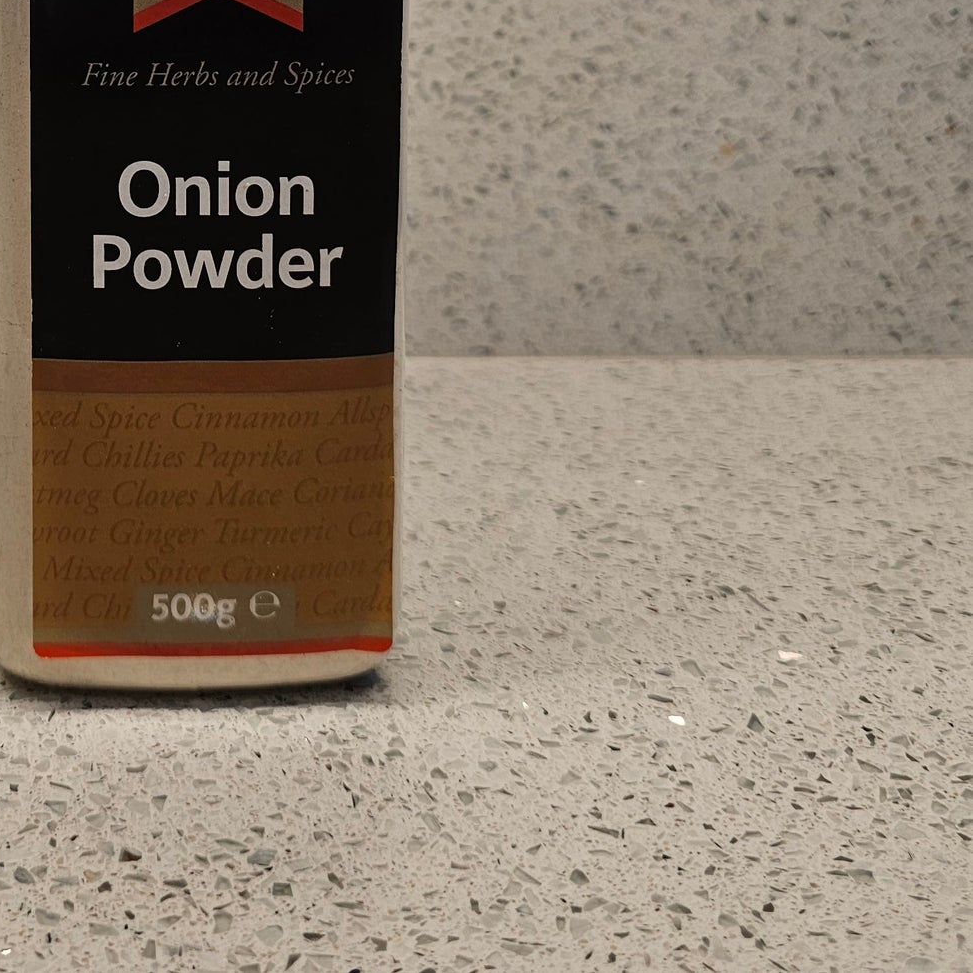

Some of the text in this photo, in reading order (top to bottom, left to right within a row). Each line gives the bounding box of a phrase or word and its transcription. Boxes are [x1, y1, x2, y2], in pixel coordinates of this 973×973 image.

[81, 61, 356, 94] Fine Herbs and Spices
[118, 160, 315, 218] Onion
[92, 233, 344, 290] Powder
[90, 401, 162, 438] Spice
[171, 401, 320, 429] Cinnamon
[82, 439, 185, 468] Chillies
[195, 439, 304, 477] Paprika
[112, 480, 198, 508] Cloves
[205, 479, 284, 507] Mace
[110, 518, 204, 555] Ginger
[214, 517, 336, 545] Turmeric
[41, 555, 134, 581] Mixed
[139, 555, 211, 585] Spice
[151, 592, 237, 629] 500g
